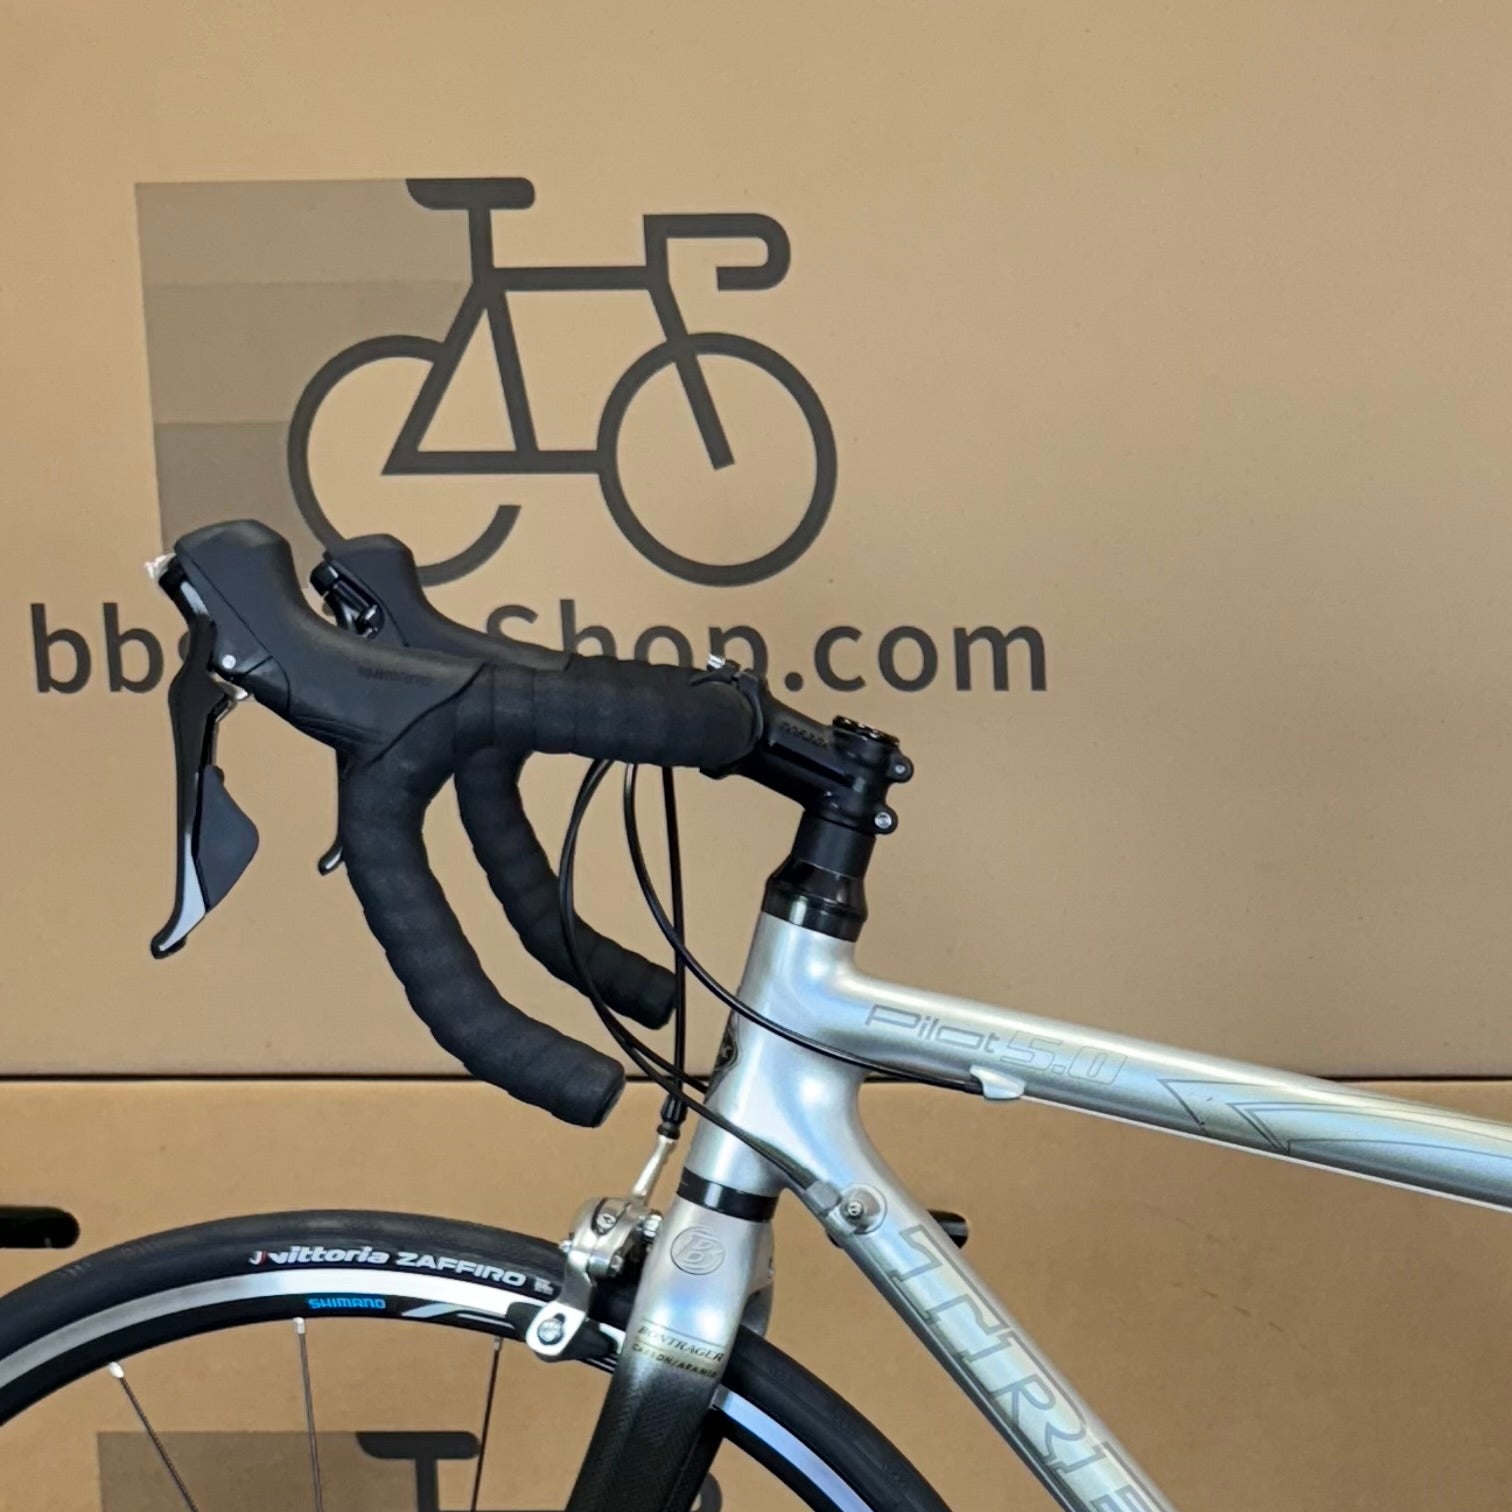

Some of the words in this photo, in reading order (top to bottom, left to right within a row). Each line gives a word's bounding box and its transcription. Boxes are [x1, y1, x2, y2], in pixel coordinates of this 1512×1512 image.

[30, 598, 1047, 694] bbho.com
[865, 1004, 1000, 1053] Pilot
[1000, 1030, 1128, 1085] 5.0
[266, 1246, 390, 1265] vittoria
[395, 1251, 526, 1287] ZAFFIRO
[308, 1298, 386, 1310] SHIMANO
[637, 1326, 725, 1361] BONTRAGER
